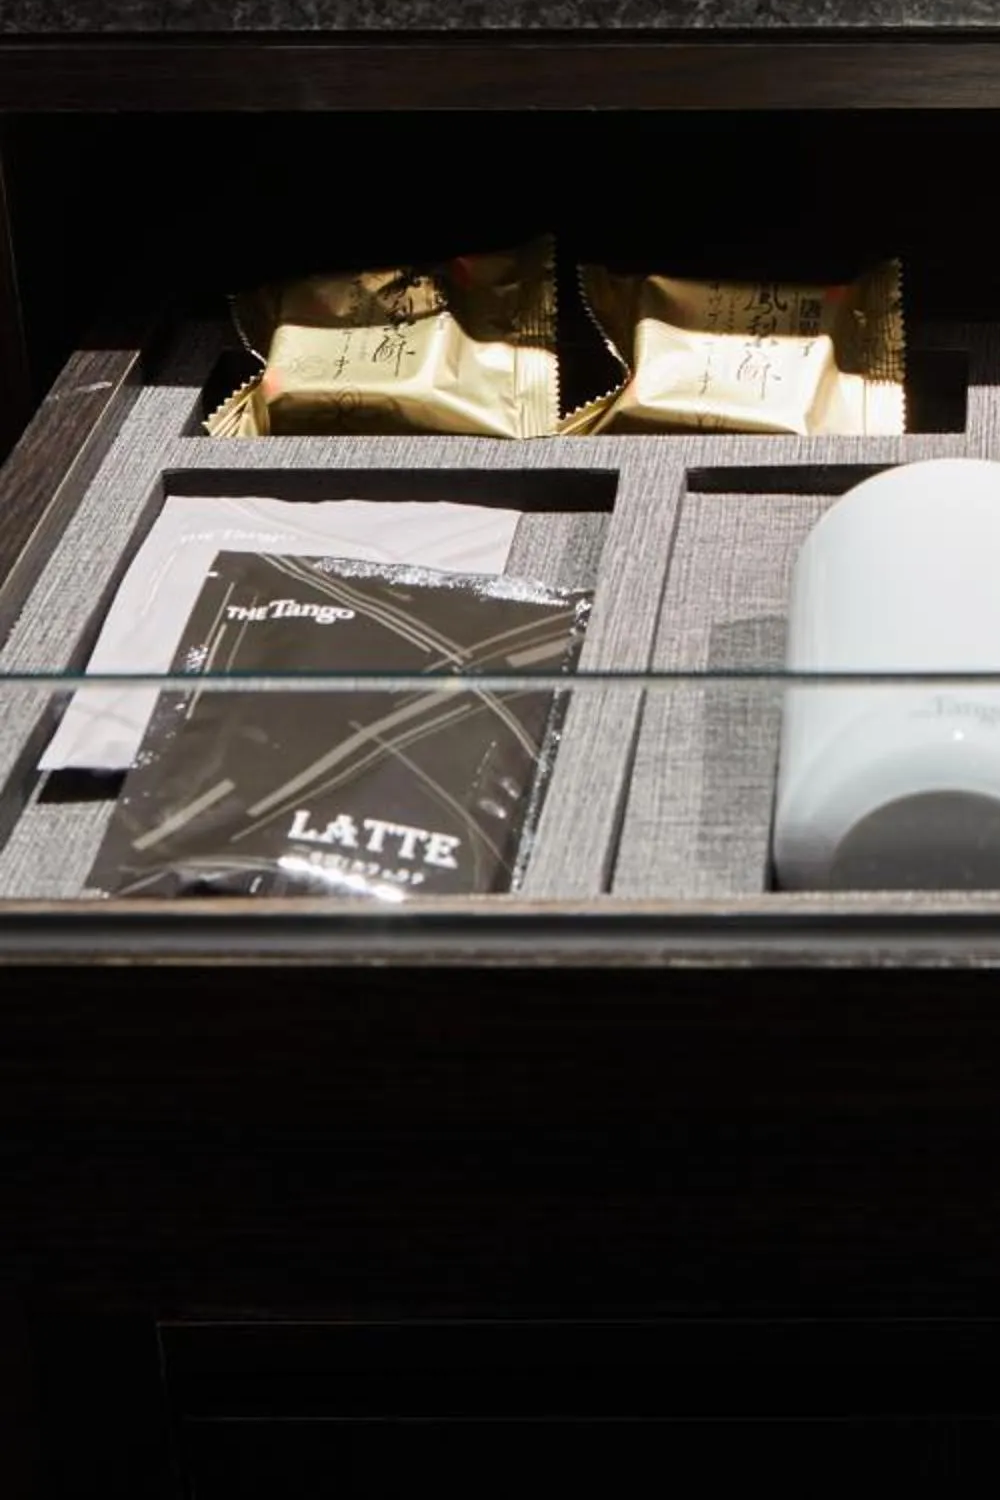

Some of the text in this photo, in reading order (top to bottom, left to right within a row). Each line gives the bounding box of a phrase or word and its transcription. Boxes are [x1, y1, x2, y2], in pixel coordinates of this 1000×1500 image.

[226, 599, 356, 625] THE Tango
[287, 809, 462, 869] LATTE
